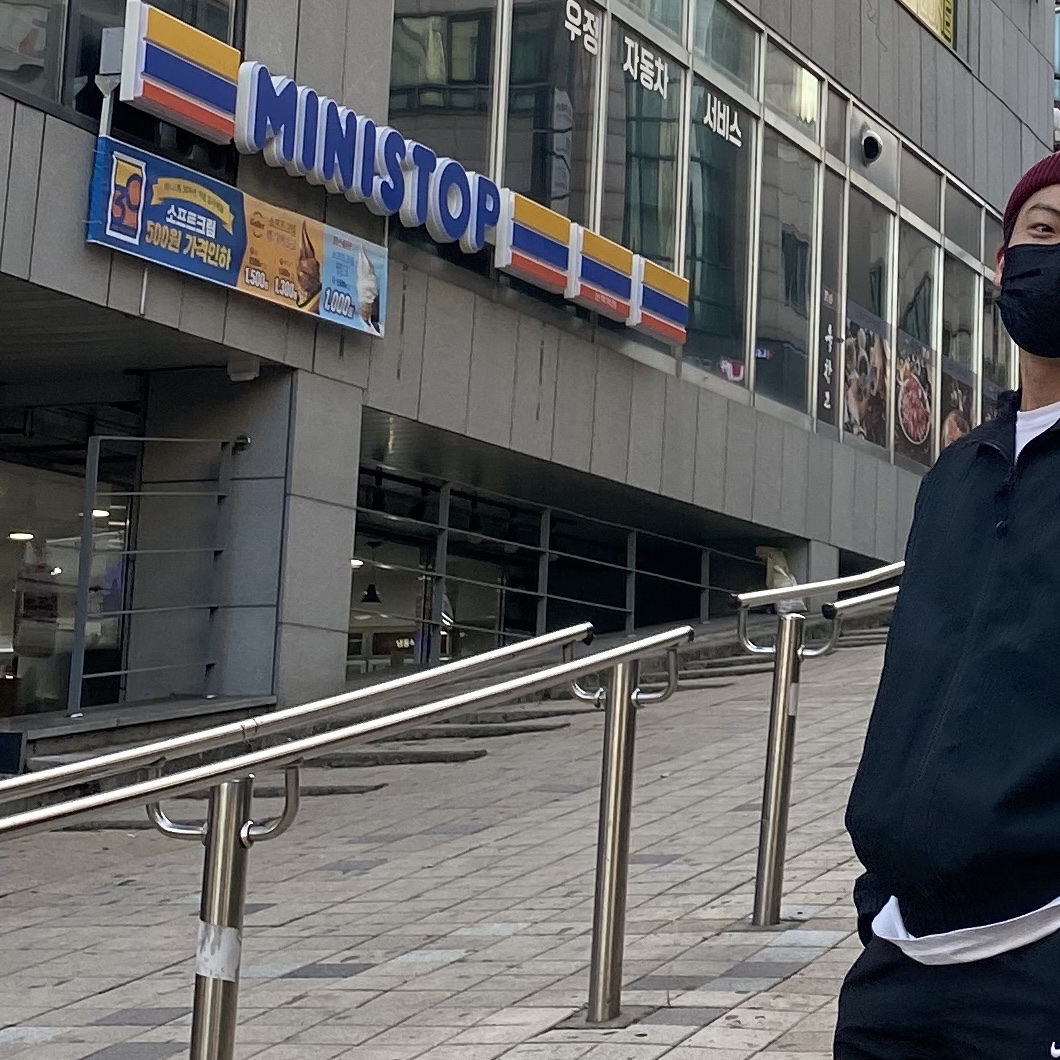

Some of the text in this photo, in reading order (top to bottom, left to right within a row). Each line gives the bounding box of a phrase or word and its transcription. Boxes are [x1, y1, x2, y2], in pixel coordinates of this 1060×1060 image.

[564, 0, 742, 148] 우정 자동차 서비스
[243, 62, 501, 253] MINISTOP
[145, 220, 182, 254] 500원
[183, 232, 232, 271] 가격인하
[165, 204, 217, 239] 소프트크림
